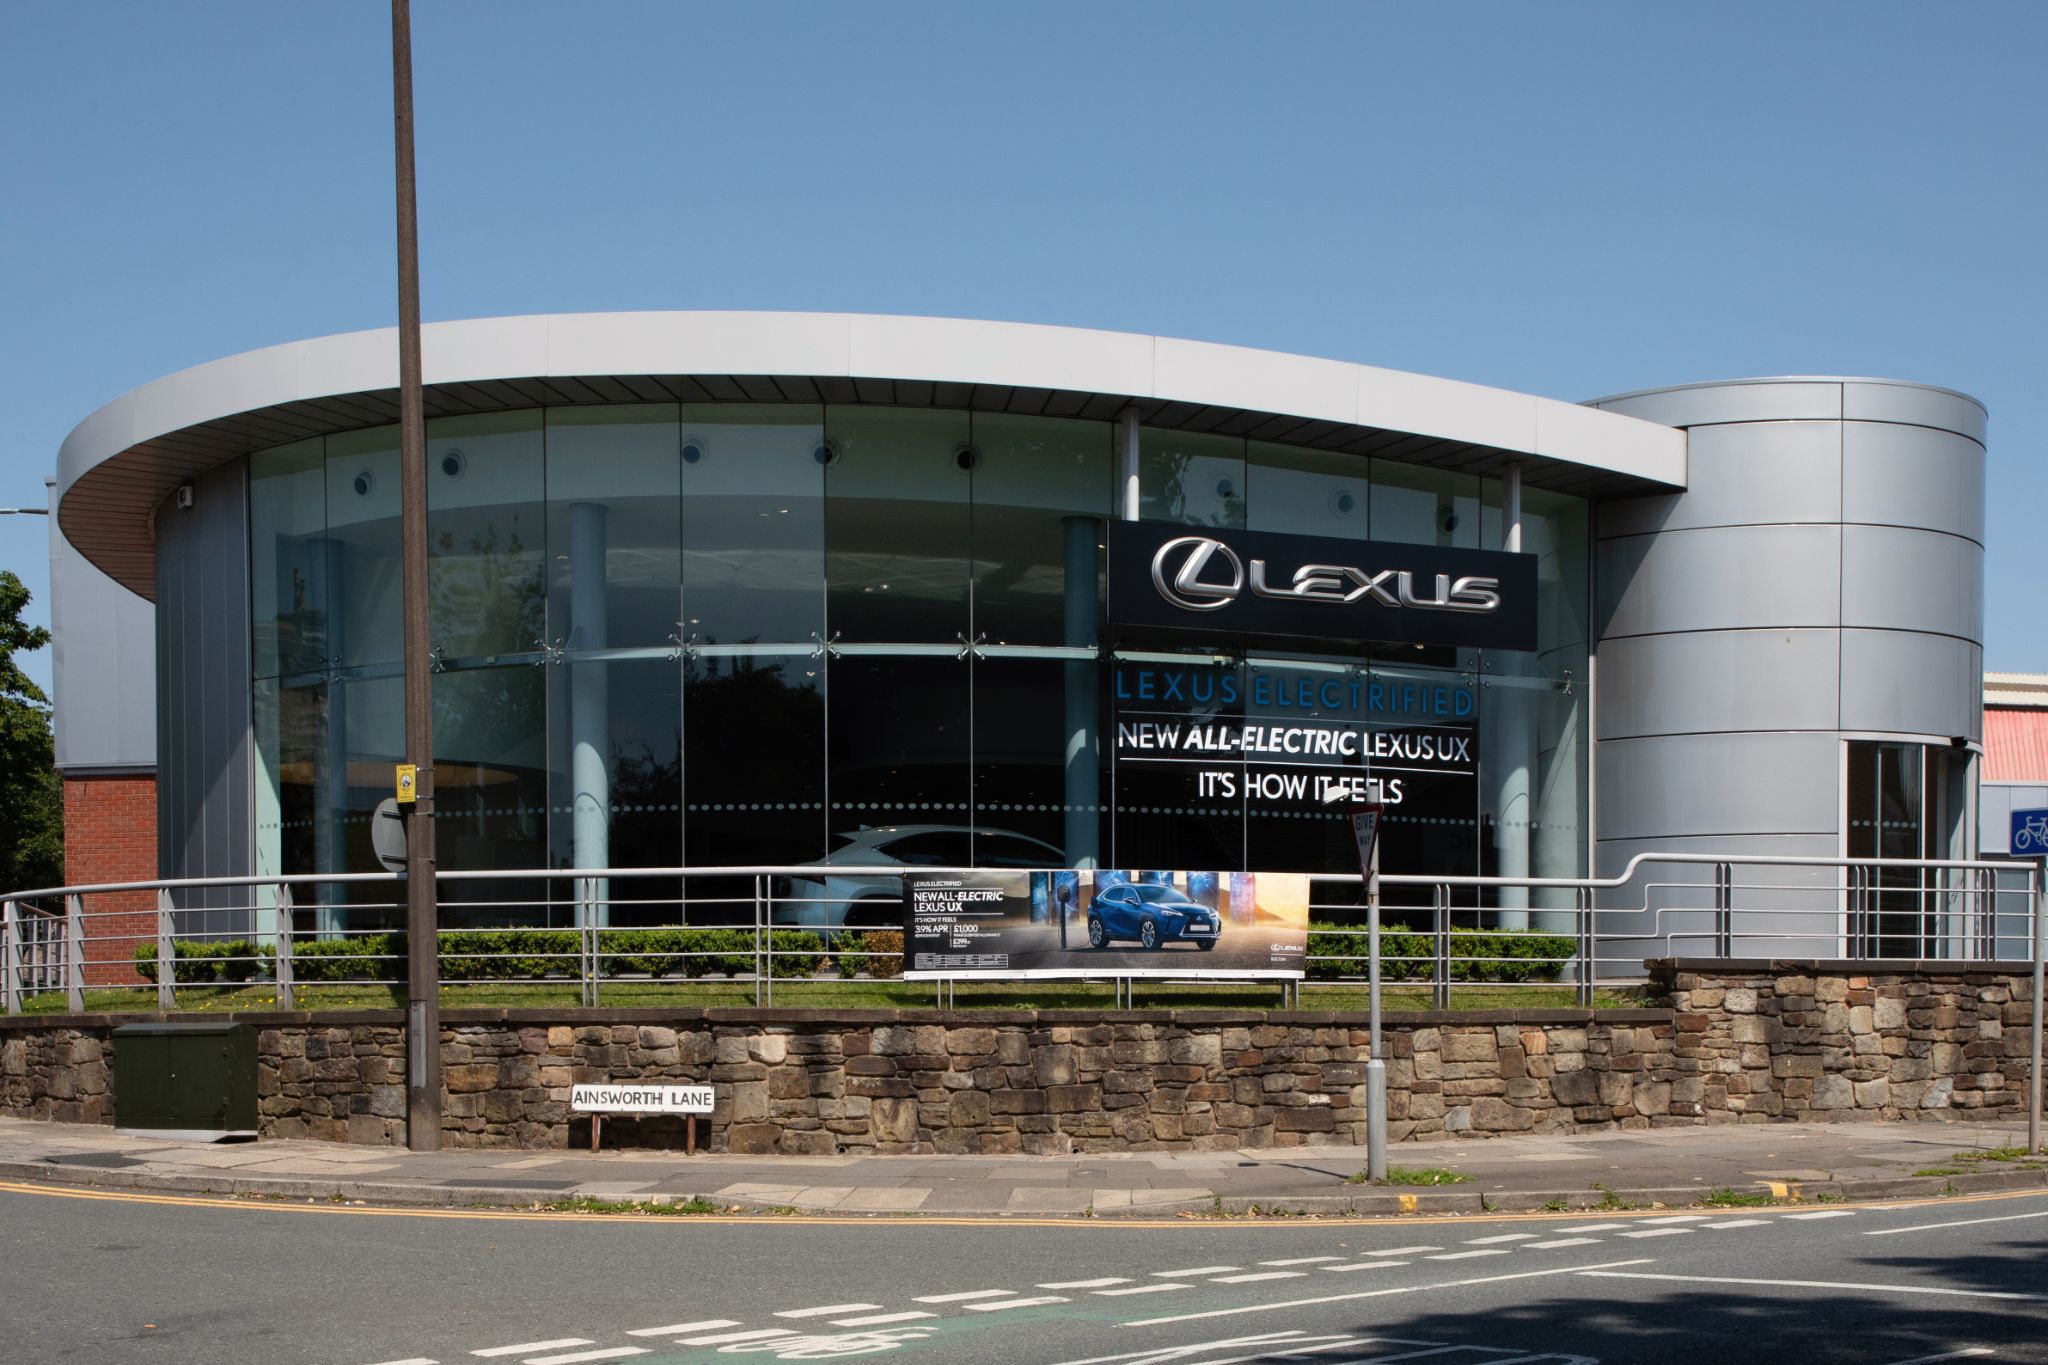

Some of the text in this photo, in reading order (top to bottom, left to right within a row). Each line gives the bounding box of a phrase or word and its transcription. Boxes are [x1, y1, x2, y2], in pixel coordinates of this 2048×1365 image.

[1249, 559, 1501, 614] LEXUS
[1116, 671, 1473, 716] LEXUS ELECTRIFIED
[1118, 722, 1471, 762] NEW ALL-ELECTRIC LEXUS UX
[1199, 772, 1236, 798] IT'S
[1245, 774, 1308, 800] HOW
[1355, 814, 1374, 831] GIVE
[1358, 834, 1371, 847] WAY
[914, 891, 1004, 902] NEW ALL-ELECTRIC
[914, 902, 963, 913] LEXUS UX
[932, 924, 949, 933] APR
[573, 1091, 712, 1106] AINSWORTH LANE
